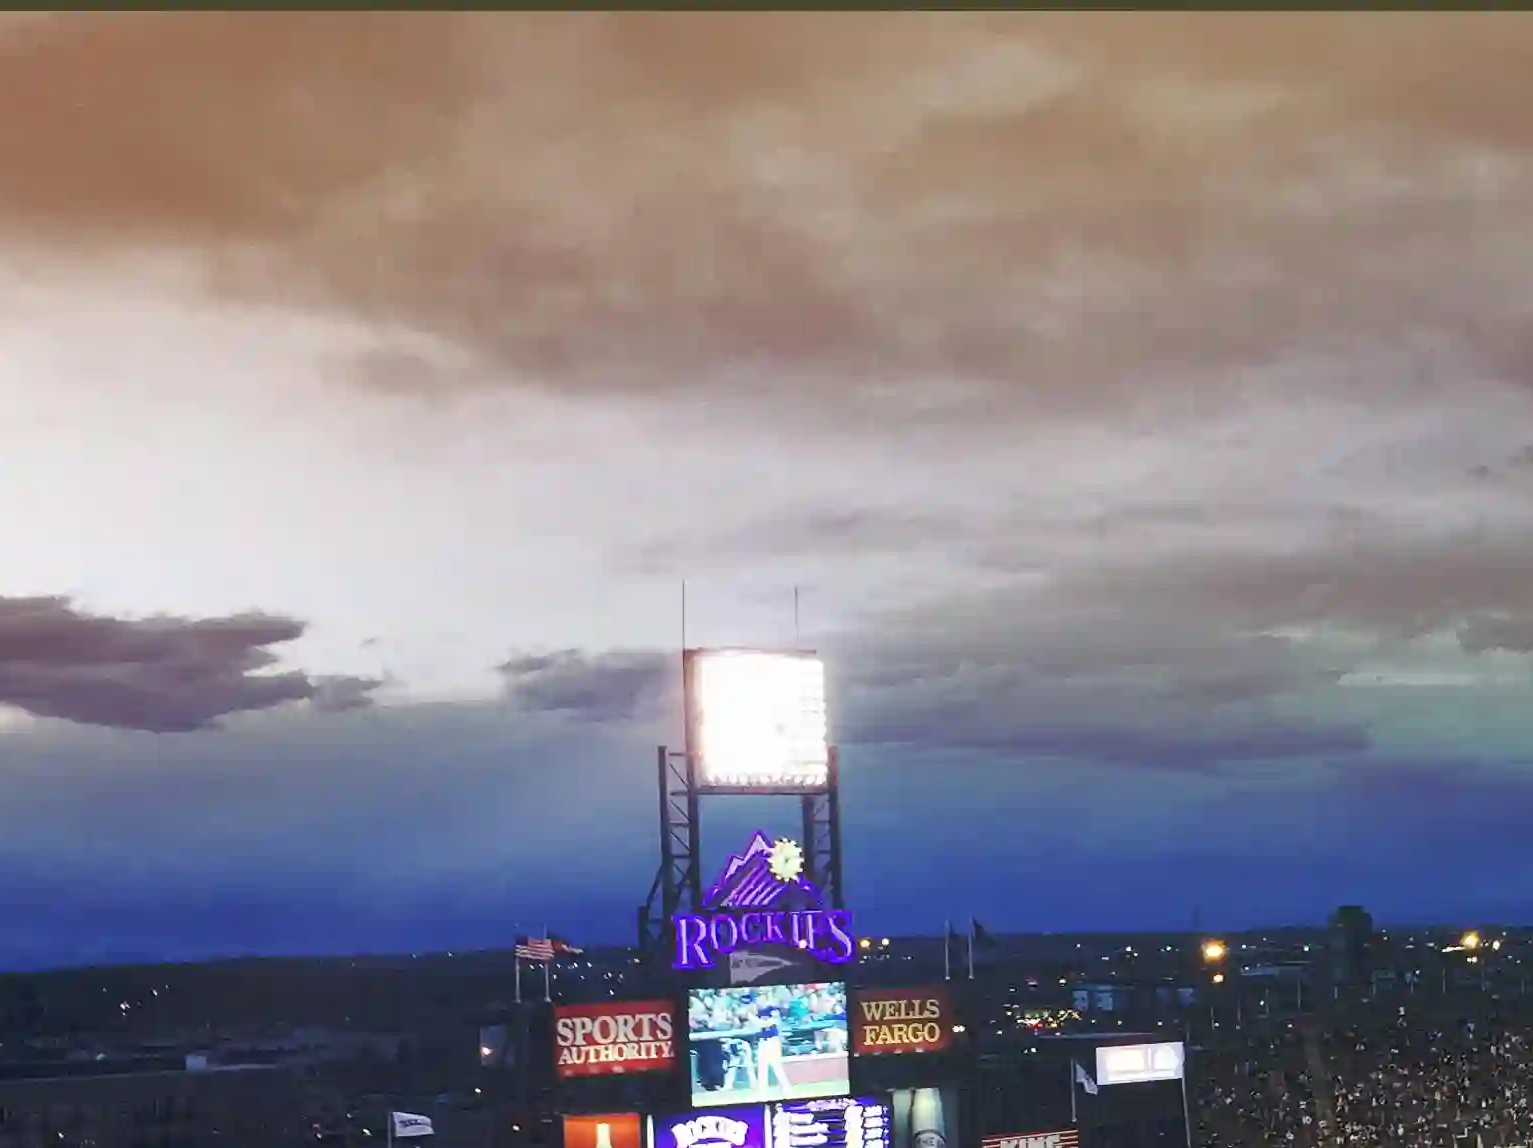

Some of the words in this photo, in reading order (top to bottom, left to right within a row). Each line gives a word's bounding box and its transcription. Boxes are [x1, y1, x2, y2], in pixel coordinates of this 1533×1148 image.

[672, 909, 856, 970] ROCKIES
[861, 999, 940, 1019] WELLS
[557, 1012, 673, 1048] SPORTS
[863, 1022, 941, 1047] FARGO
